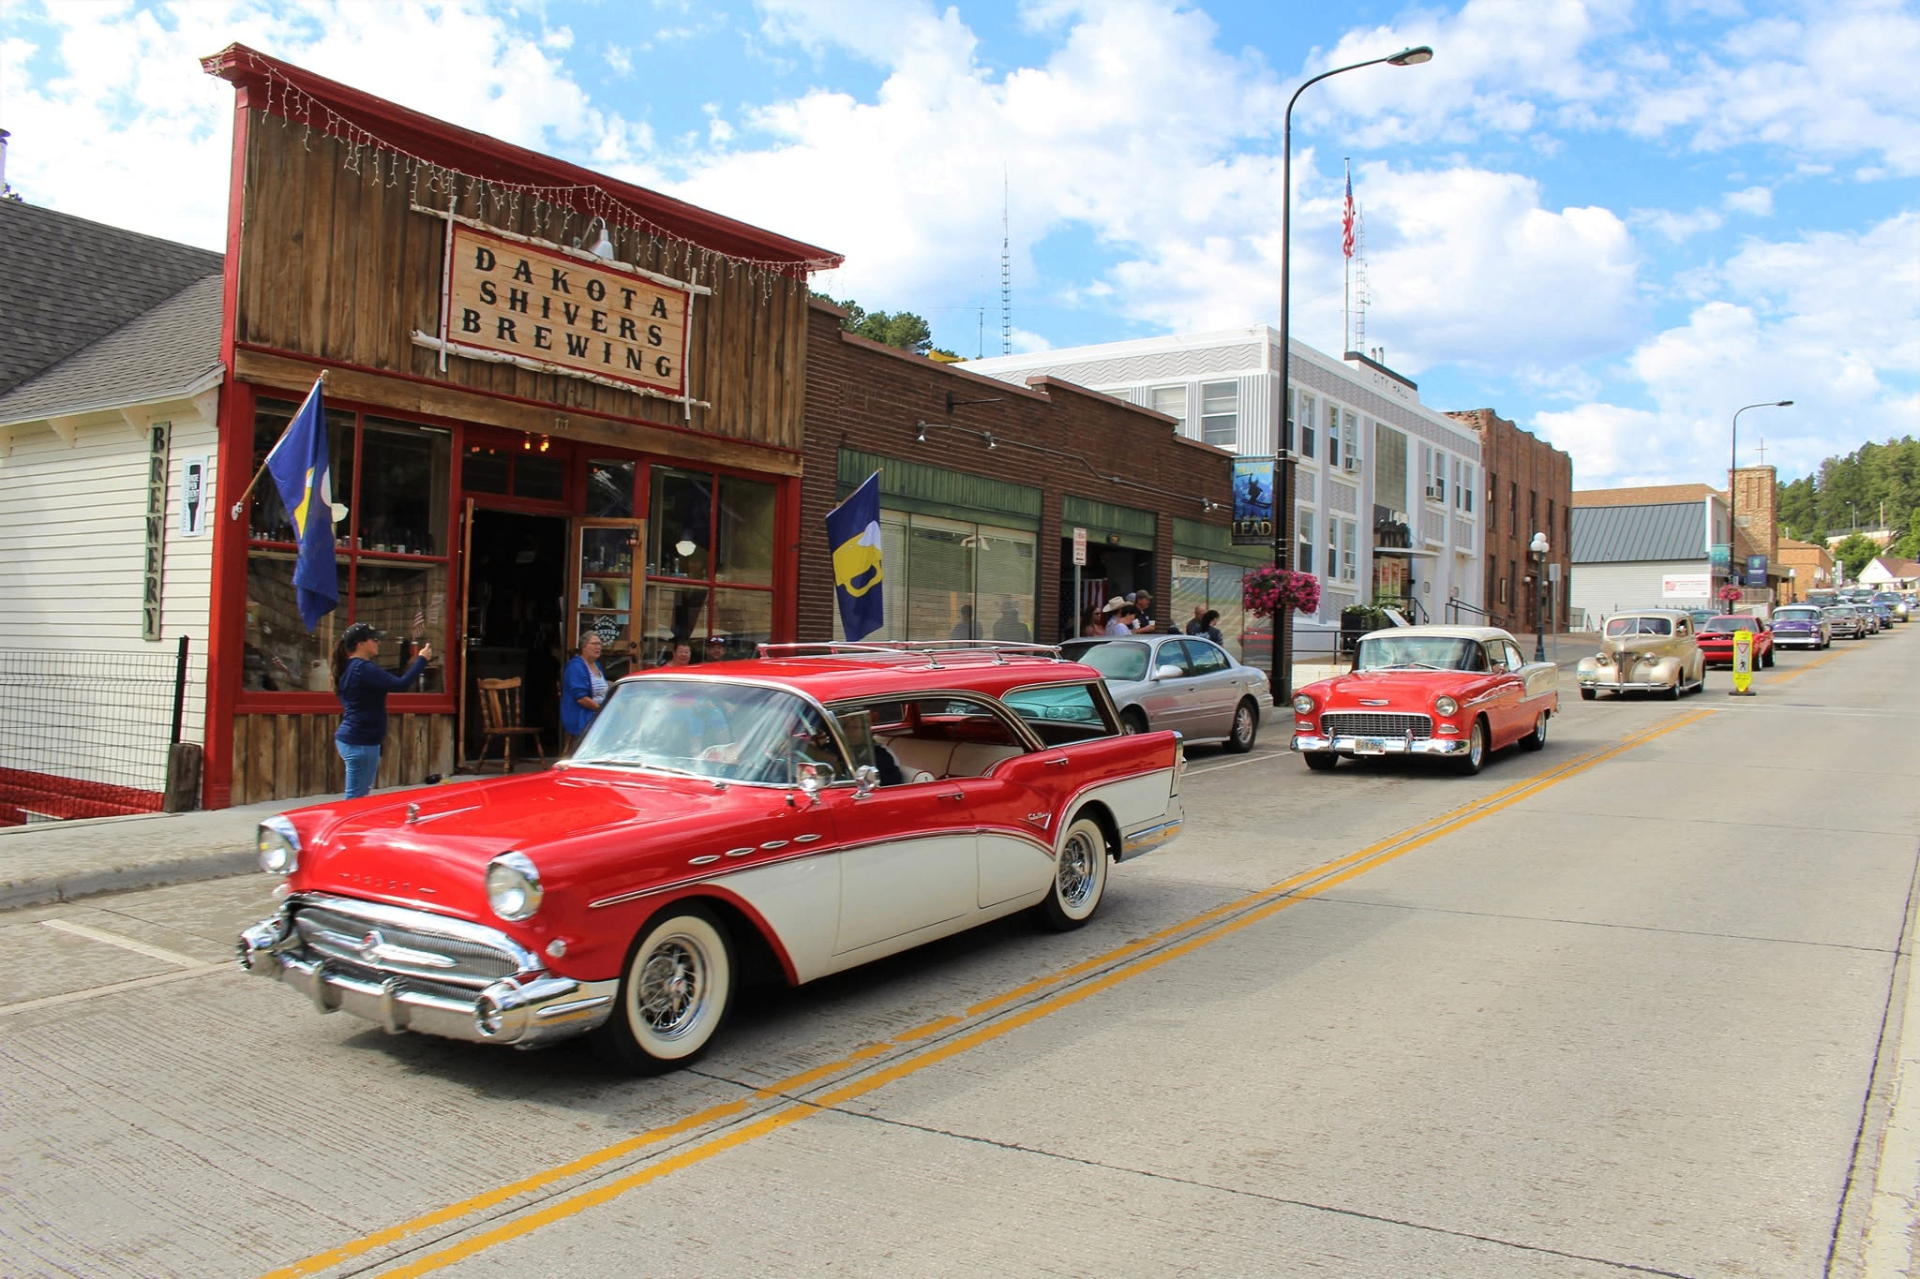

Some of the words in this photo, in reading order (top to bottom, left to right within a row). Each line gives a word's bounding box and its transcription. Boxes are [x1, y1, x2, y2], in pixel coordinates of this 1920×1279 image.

[475, 246, 668, 320] DAKOTA
[479, 279, 663, 347] SHIVERS
[461, 307, 672, 378] BREWING
[145, 426, 166, 636] BREWERY
[1232, 521, 1272, 536] LEAD
